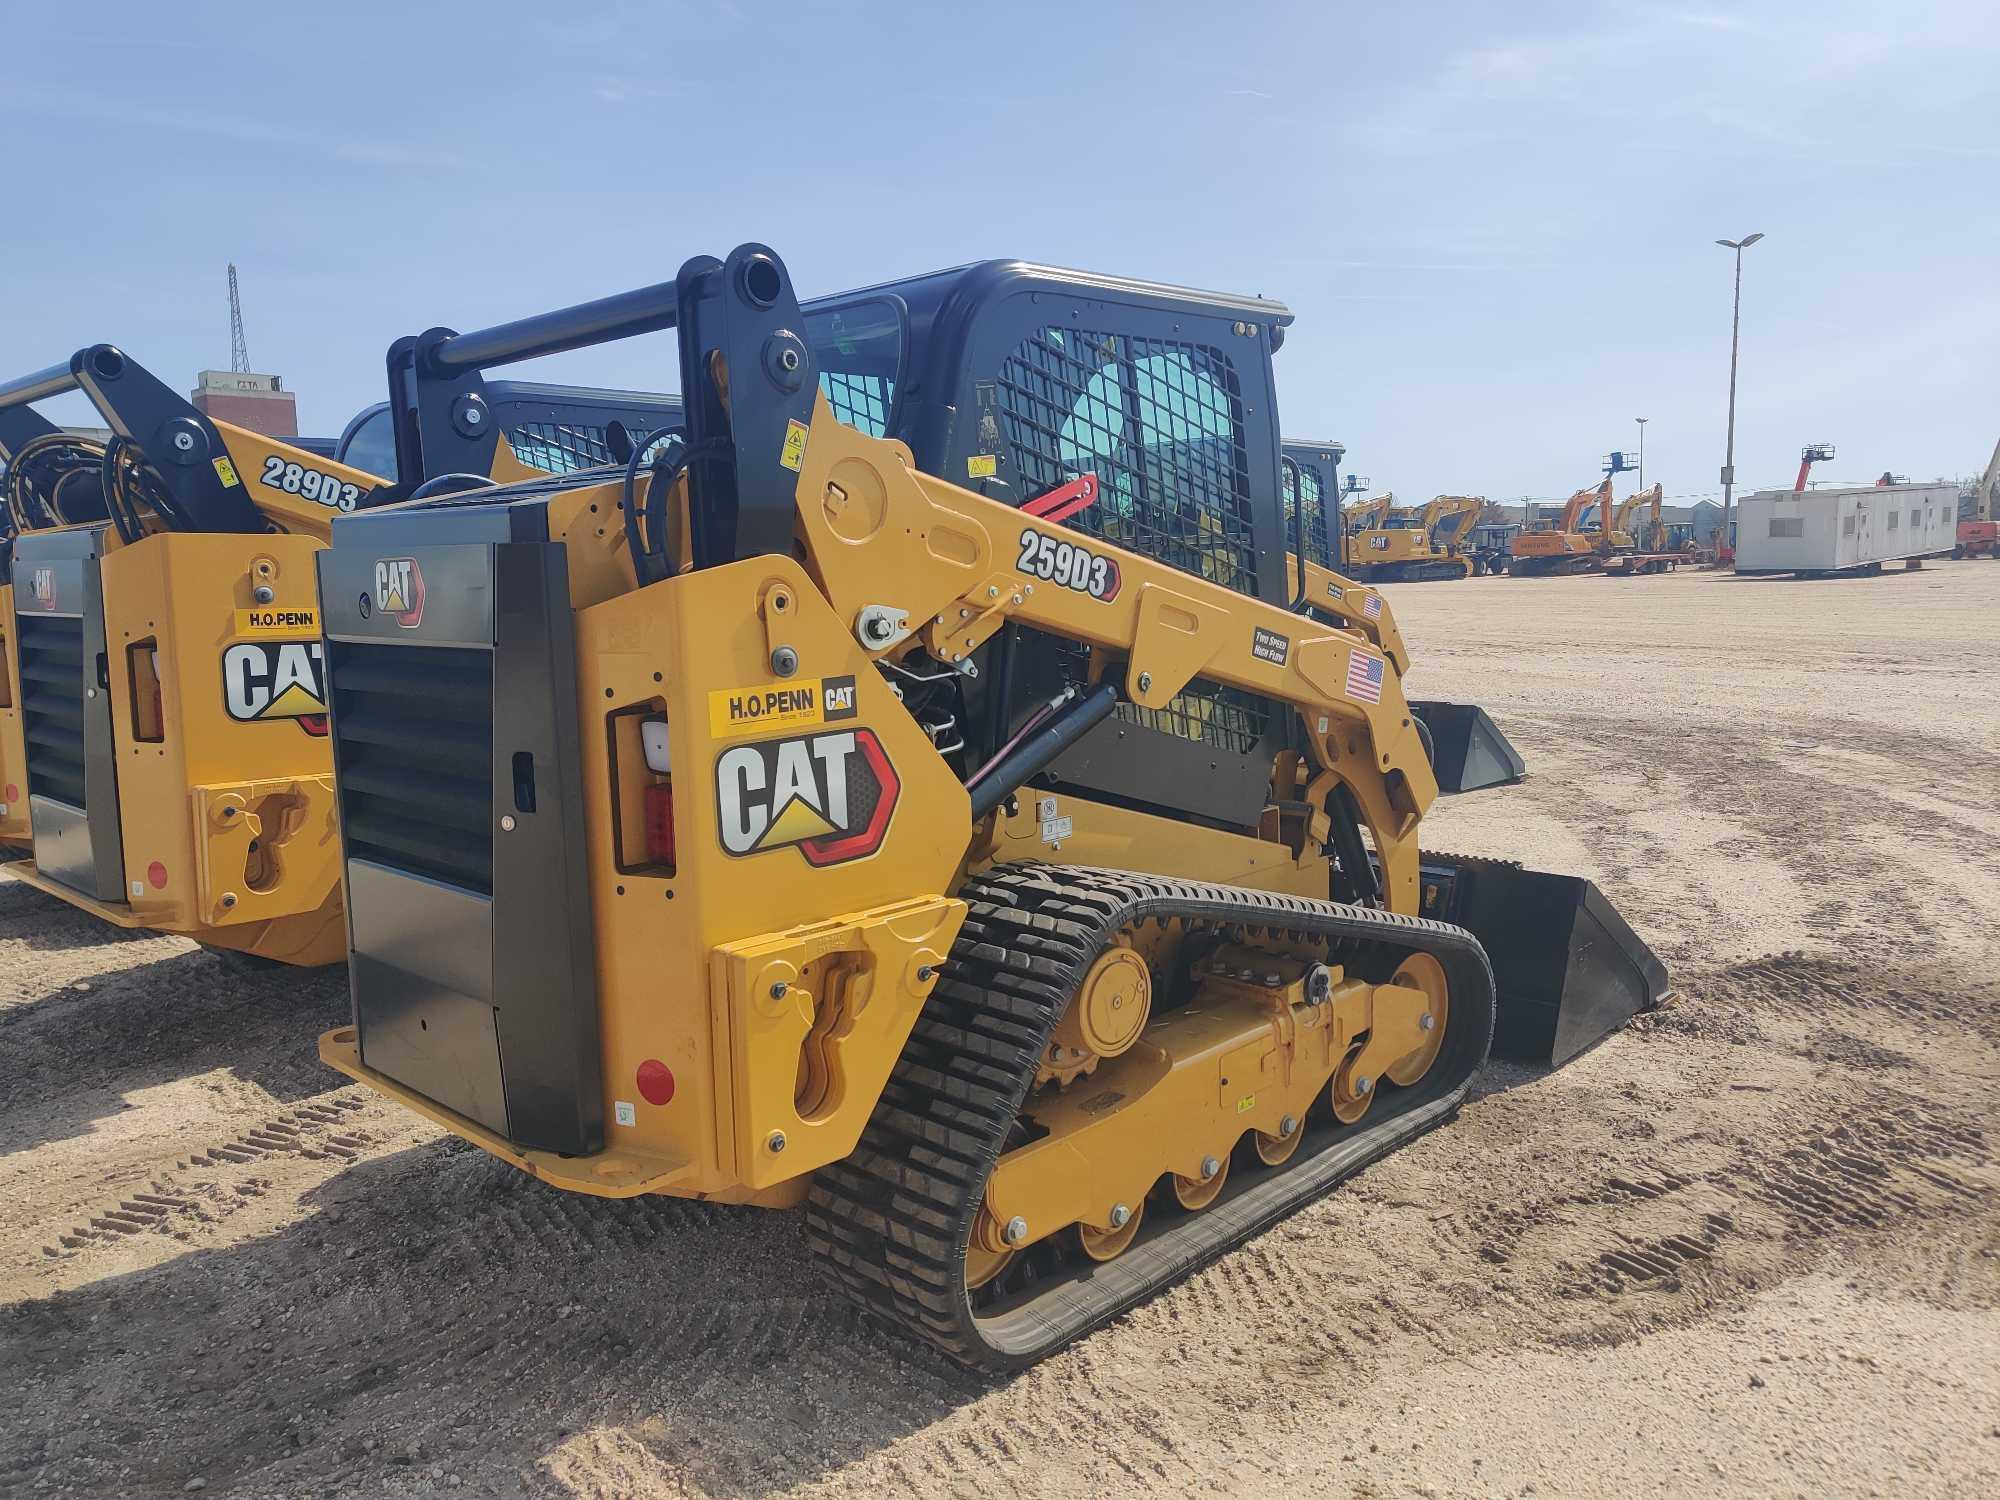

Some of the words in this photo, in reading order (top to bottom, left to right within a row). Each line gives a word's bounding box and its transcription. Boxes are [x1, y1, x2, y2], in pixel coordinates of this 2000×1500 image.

[261, 456, 359, 512] 289D3
[1370, 536, 1386, 548] CAT
[1017, 529, 1108, 597] 259D3
[36, 570, 50, 600] CAT
[375, 561, 411, 610] CAT
[249, 612, 314, 626] H.O.PENN
[224, 643, 322, 719] CA
[825, 686, 856, 711] CAT
[729, 688, 814, 720] H.O.PENN
[718, 732, 856, 853] CAT
